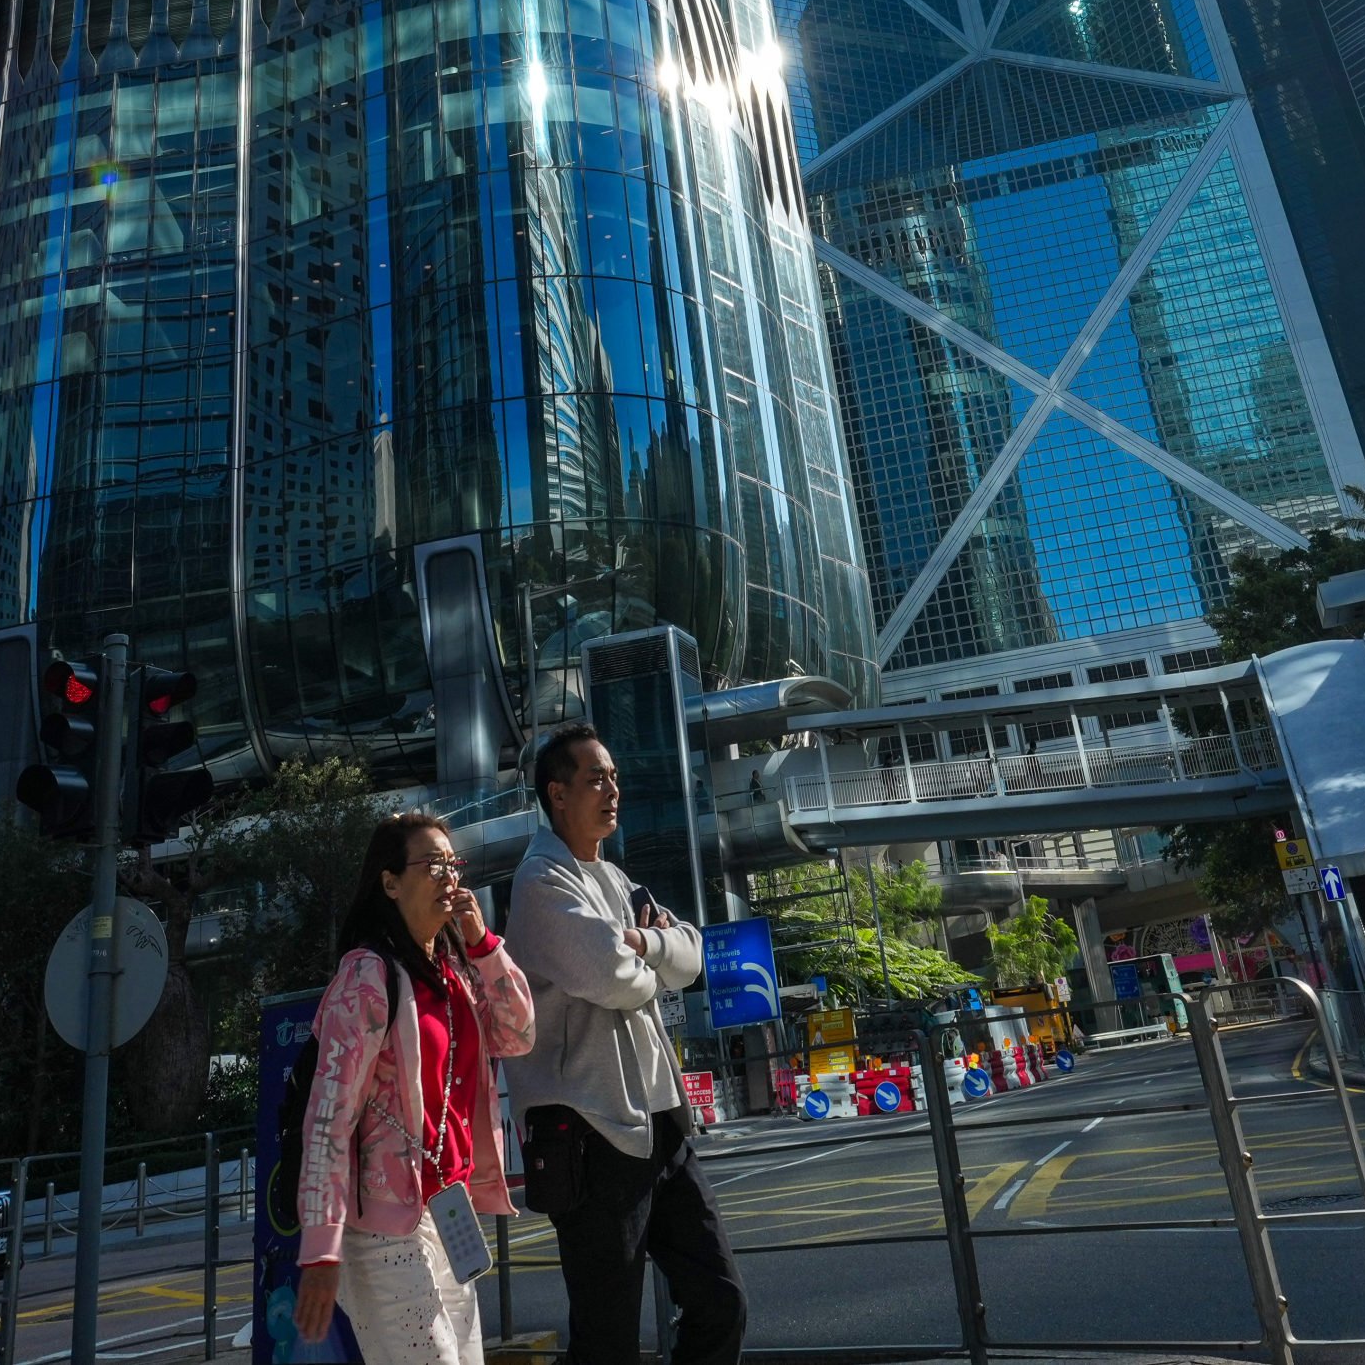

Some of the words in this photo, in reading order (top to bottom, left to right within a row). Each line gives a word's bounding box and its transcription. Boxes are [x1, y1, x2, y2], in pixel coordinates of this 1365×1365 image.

[1306, 880, 1318, 890] 12
[705, 927, 737, 937] Admiralty
[712, 985, 741, 996] Kowloon
[676, 1015, 685, 1023] 12
